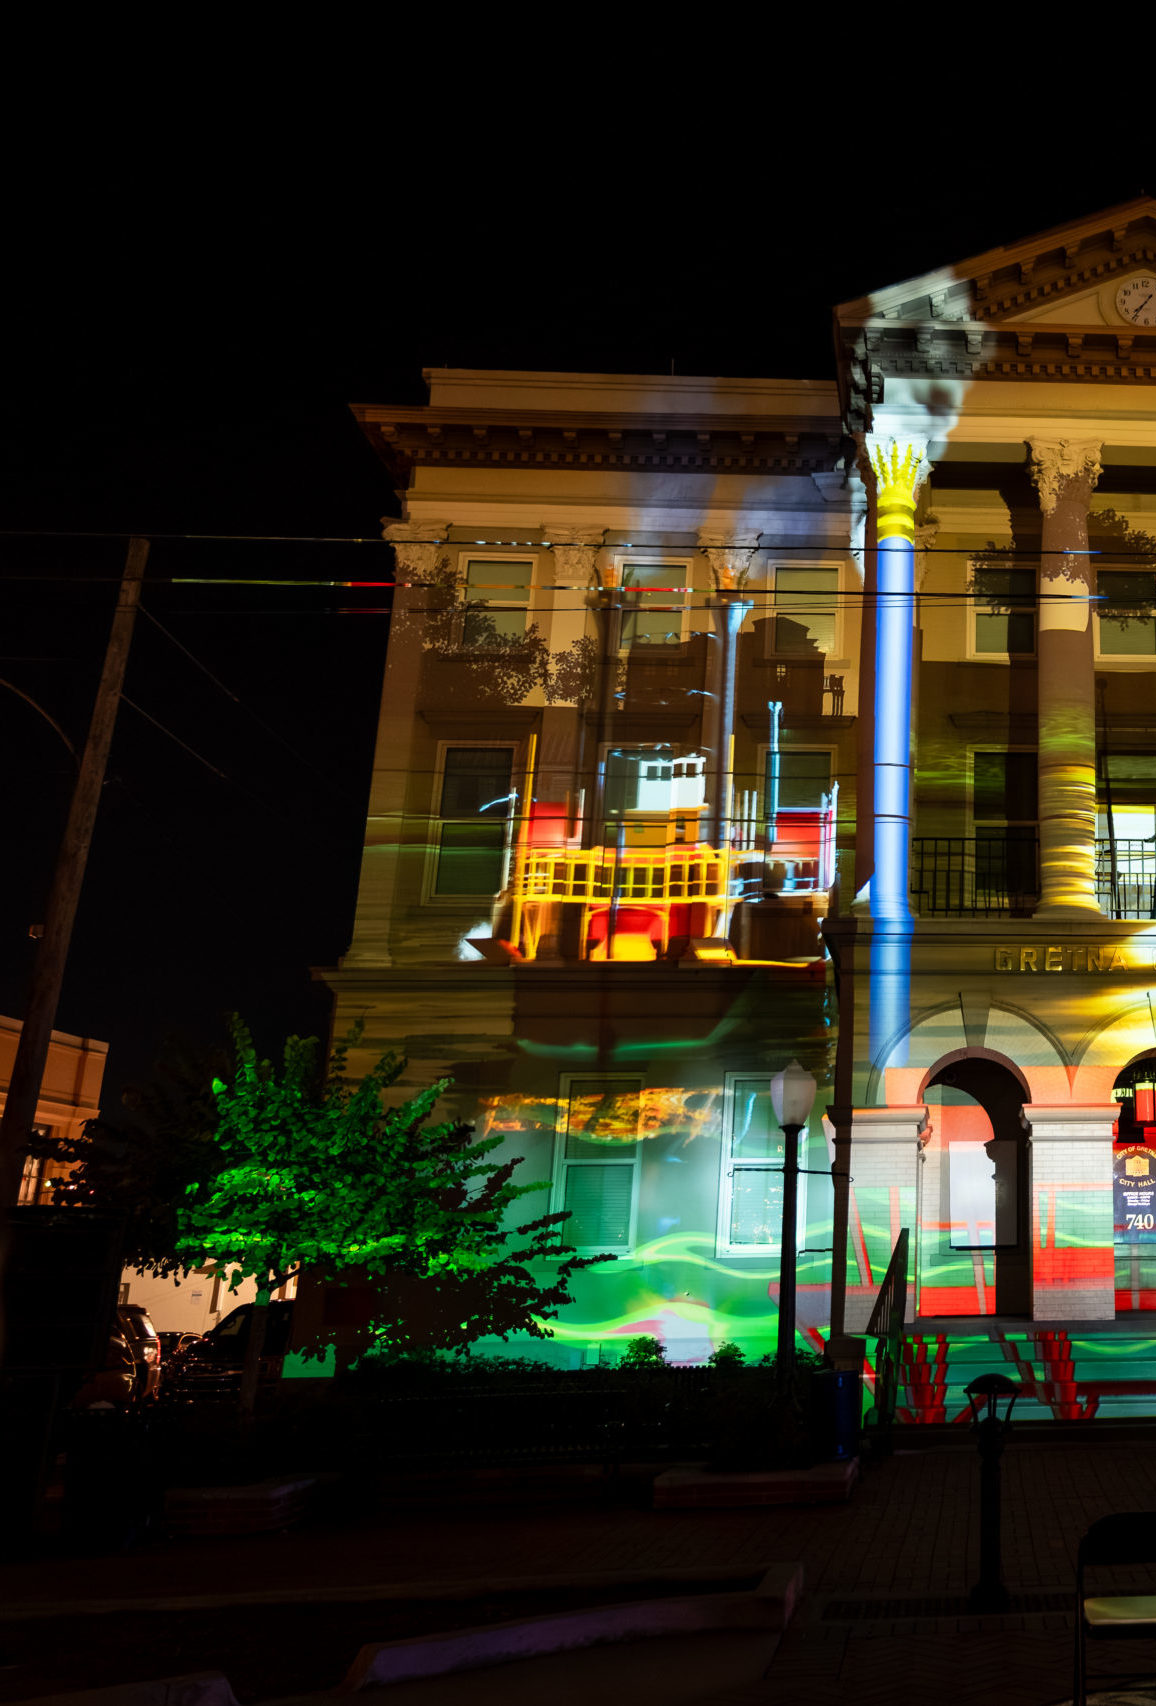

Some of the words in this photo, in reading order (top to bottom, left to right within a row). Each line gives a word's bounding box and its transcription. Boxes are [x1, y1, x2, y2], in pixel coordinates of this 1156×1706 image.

[1141, 280, 1150, 288] 12
[995, 946, 1129, 972] GRETNA
[1116, 1148, 1128, 1160] CITY
[1119, 1178, 1136, 1188] CITY
[1138, 1178, 1156, 1188] HALL
[1125, 1213, 1154, 1230] 740
